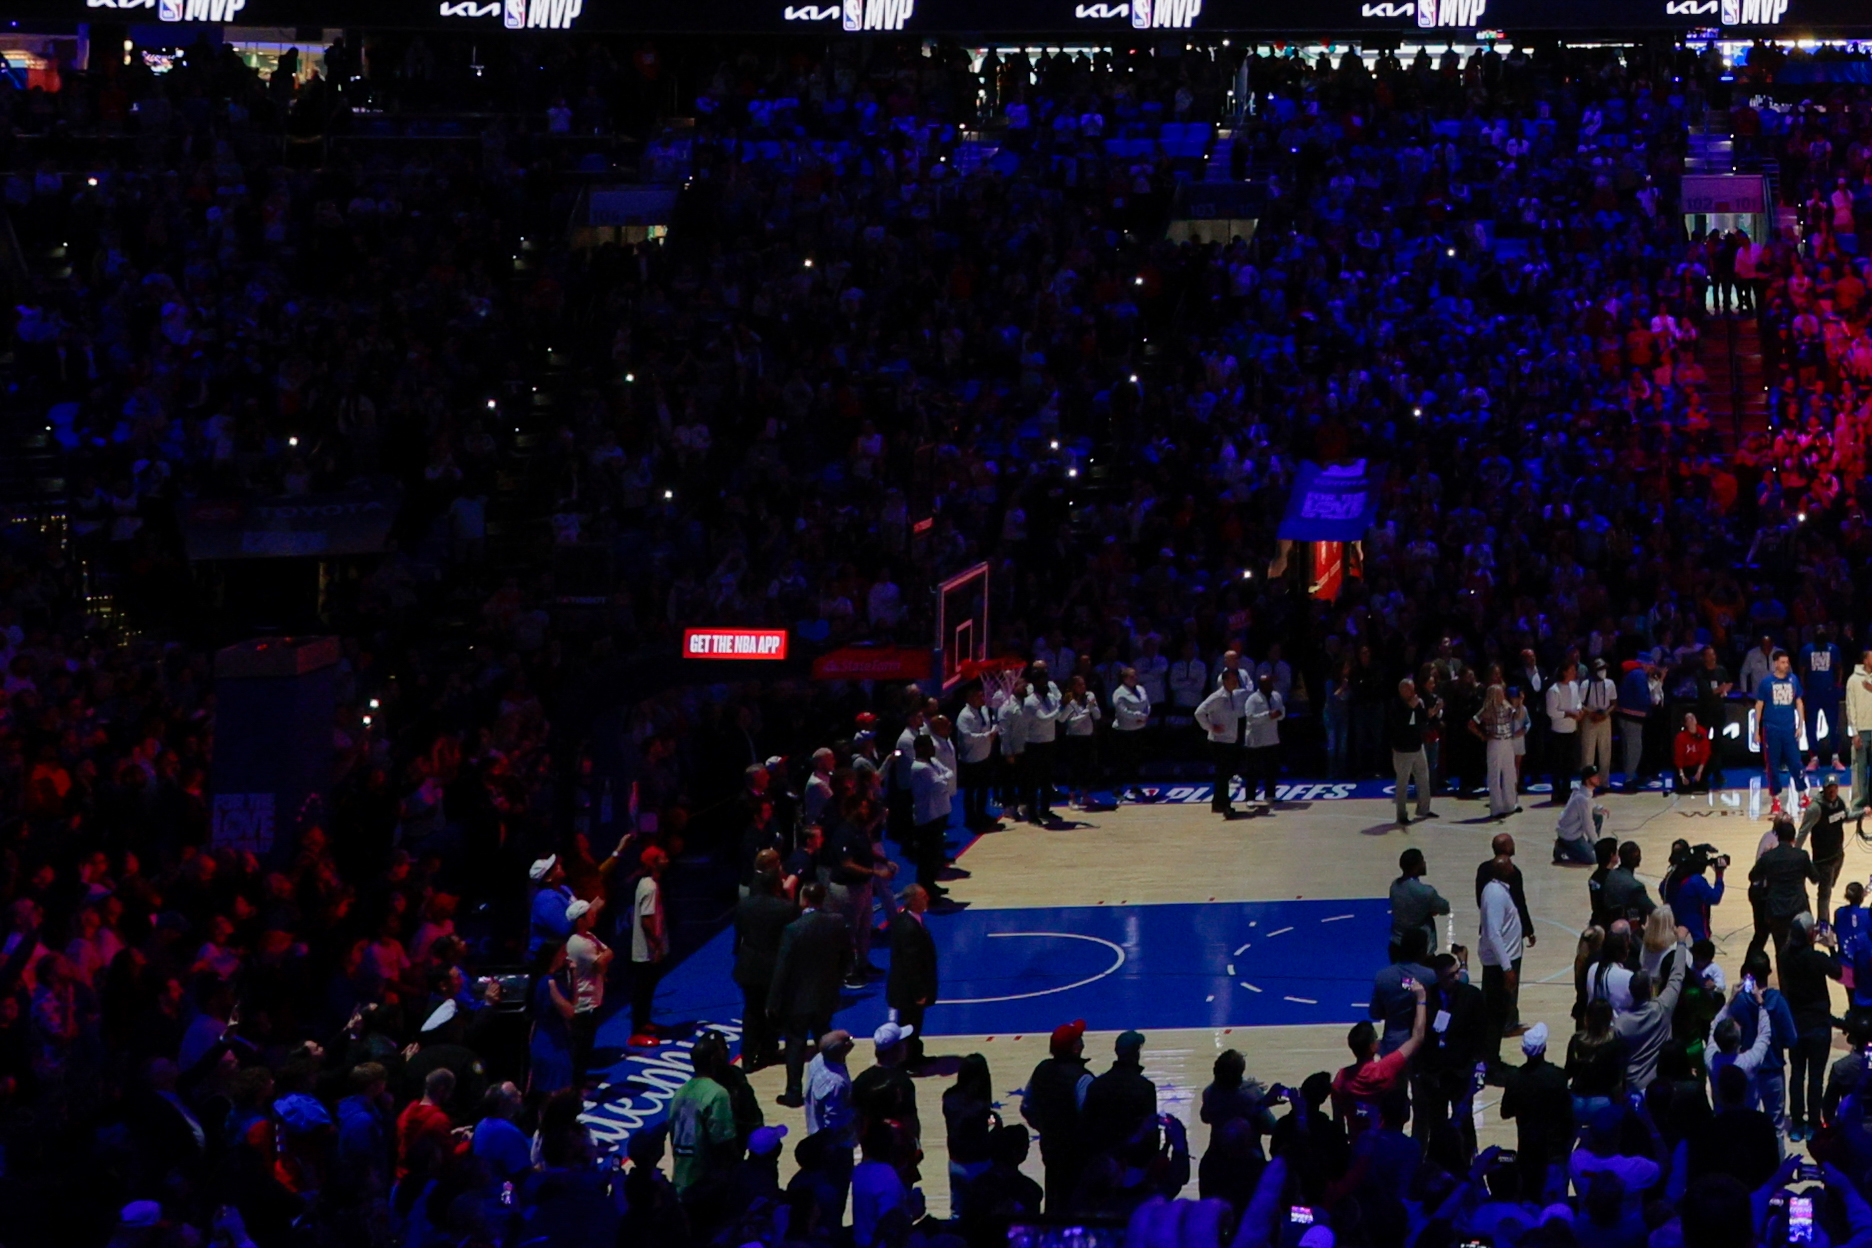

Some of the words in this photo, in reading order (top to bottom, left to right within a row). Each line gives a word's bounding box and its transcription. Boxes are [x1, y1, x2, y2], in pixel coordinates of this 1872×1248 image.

[255, 499, 386, 519] TOYOTA
[690, 634, 711, 653] GET
[712, 635, 733, 653] THE
[734, 635, 757, 653] NBA
[758, 636, 780, 654] APP
[1165, 783, 1358, 804] PLOFFS
[211, 808, 277, 840] LOVE
